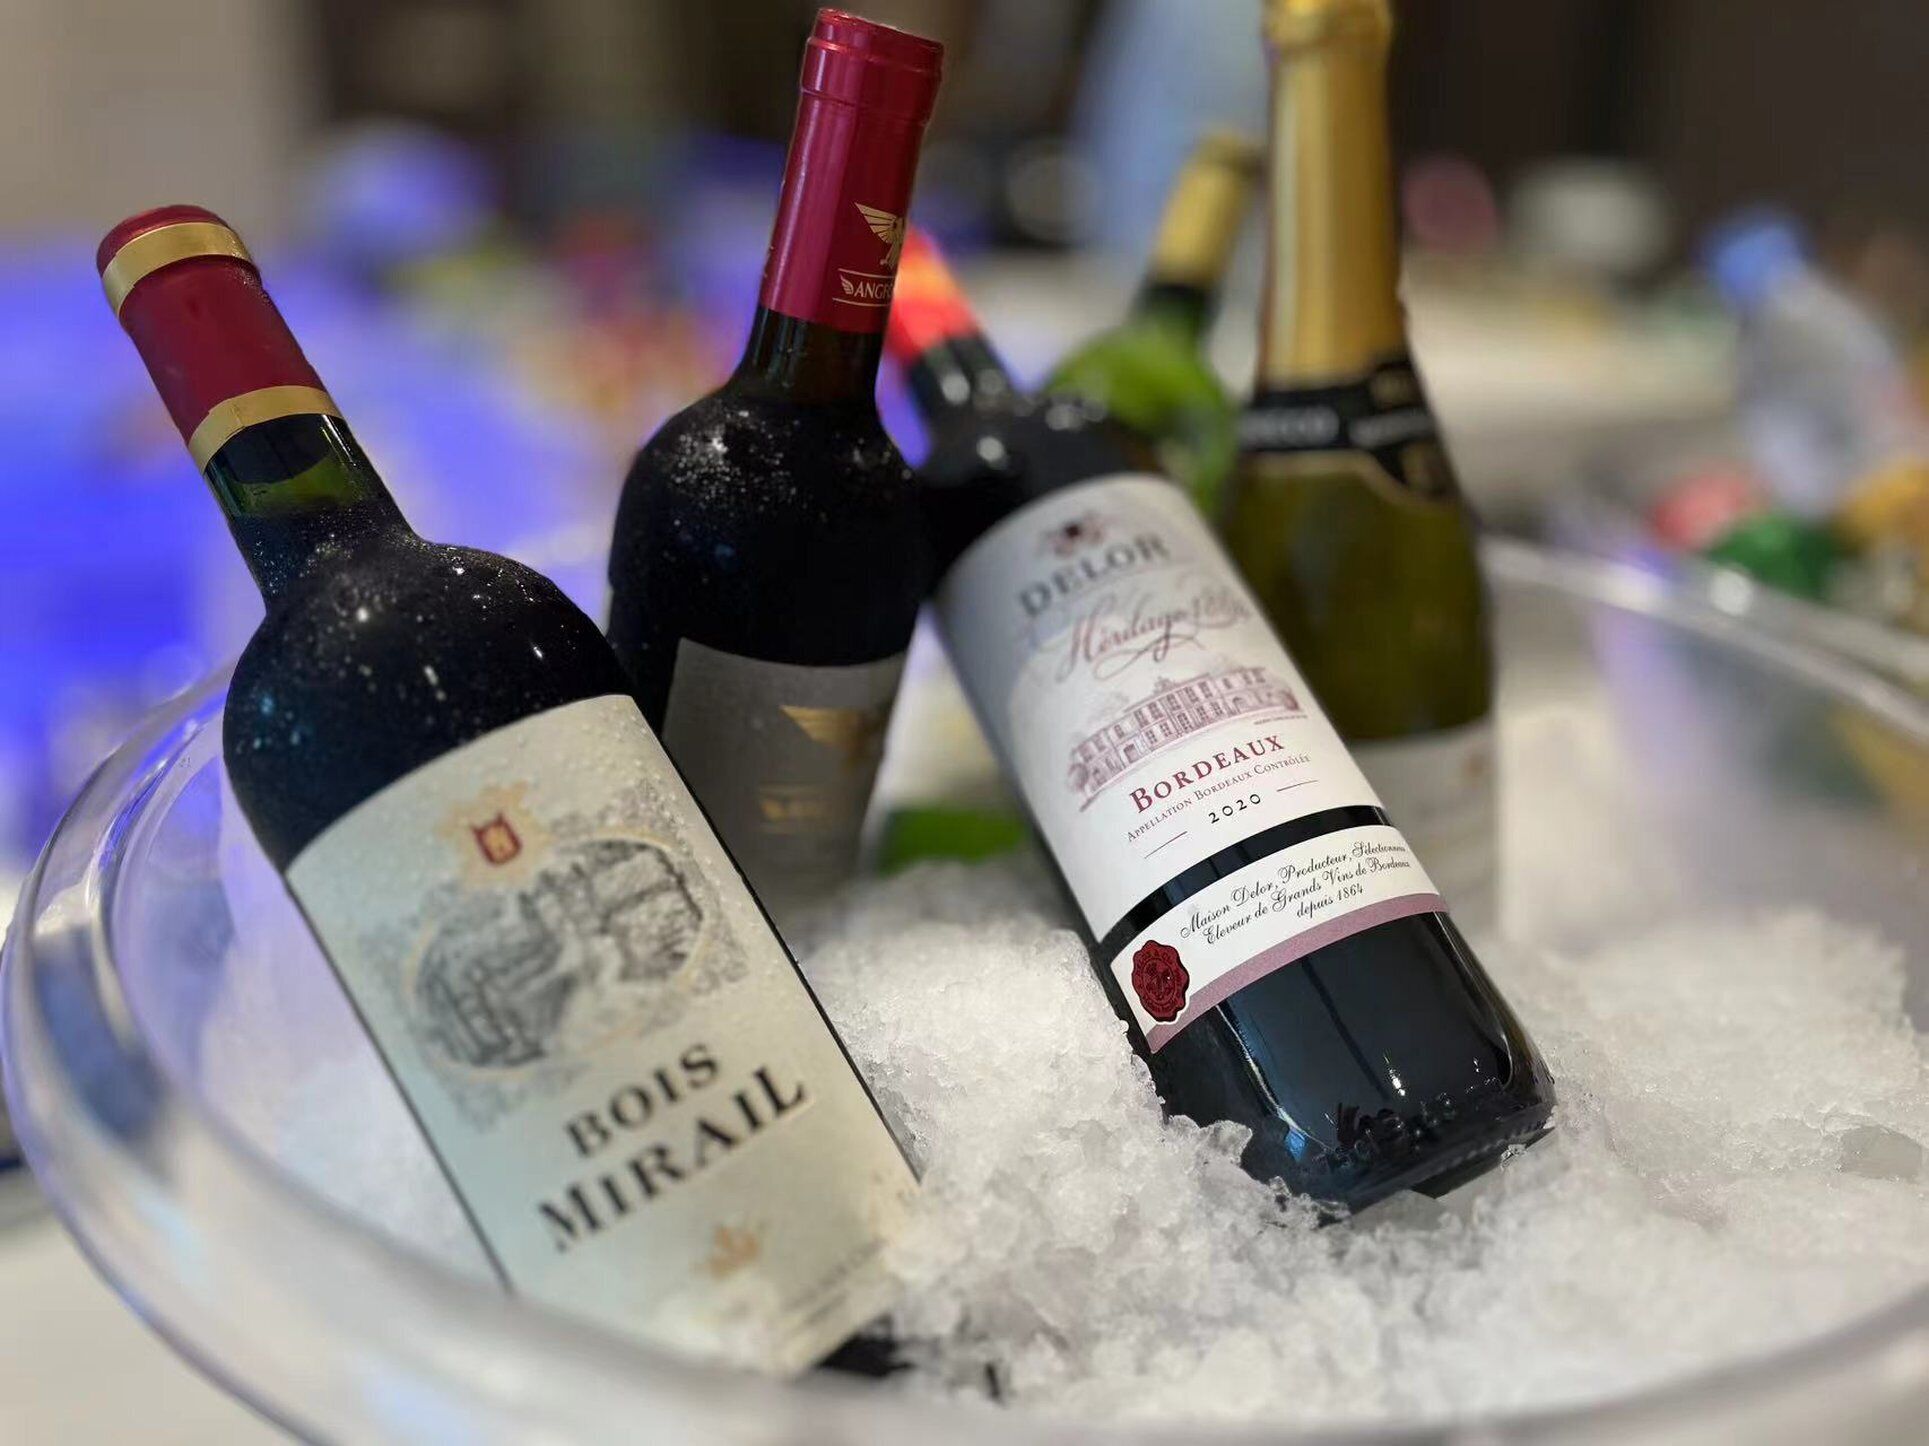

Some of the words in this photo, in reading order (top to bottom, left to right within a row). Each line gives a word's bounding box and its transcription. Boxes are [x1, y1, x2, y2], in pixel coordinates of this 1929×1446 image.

[1018, 533, 1169, 617] DELOR
[1127, 797, 1192, 842] APPELLATION
[1194, 770, 1253, 801] BORDEAUX
[1129, 735, 1284, 813] BORDEAUX
[1208, 793, 1261, 824] 2020
[1180, 904, 1231, 939] Maison
[1231, 881, 1278, 907] Delor,
[1278, 854, 1352, 885] Producteur,
[1254, 902, 1268, 918] de
[1271, 878, 1322, 912] Grands
[1322, 866, 1354, 885] Vins
[1355, 862, 1367, 877] de
[1296, 895, 1334, 919] depuis
[1336, 882, 1364, 903] 1864
[563, 1043, 720, 1159] BOIS
[537, 1065, 807, 1254] MIRAIL
